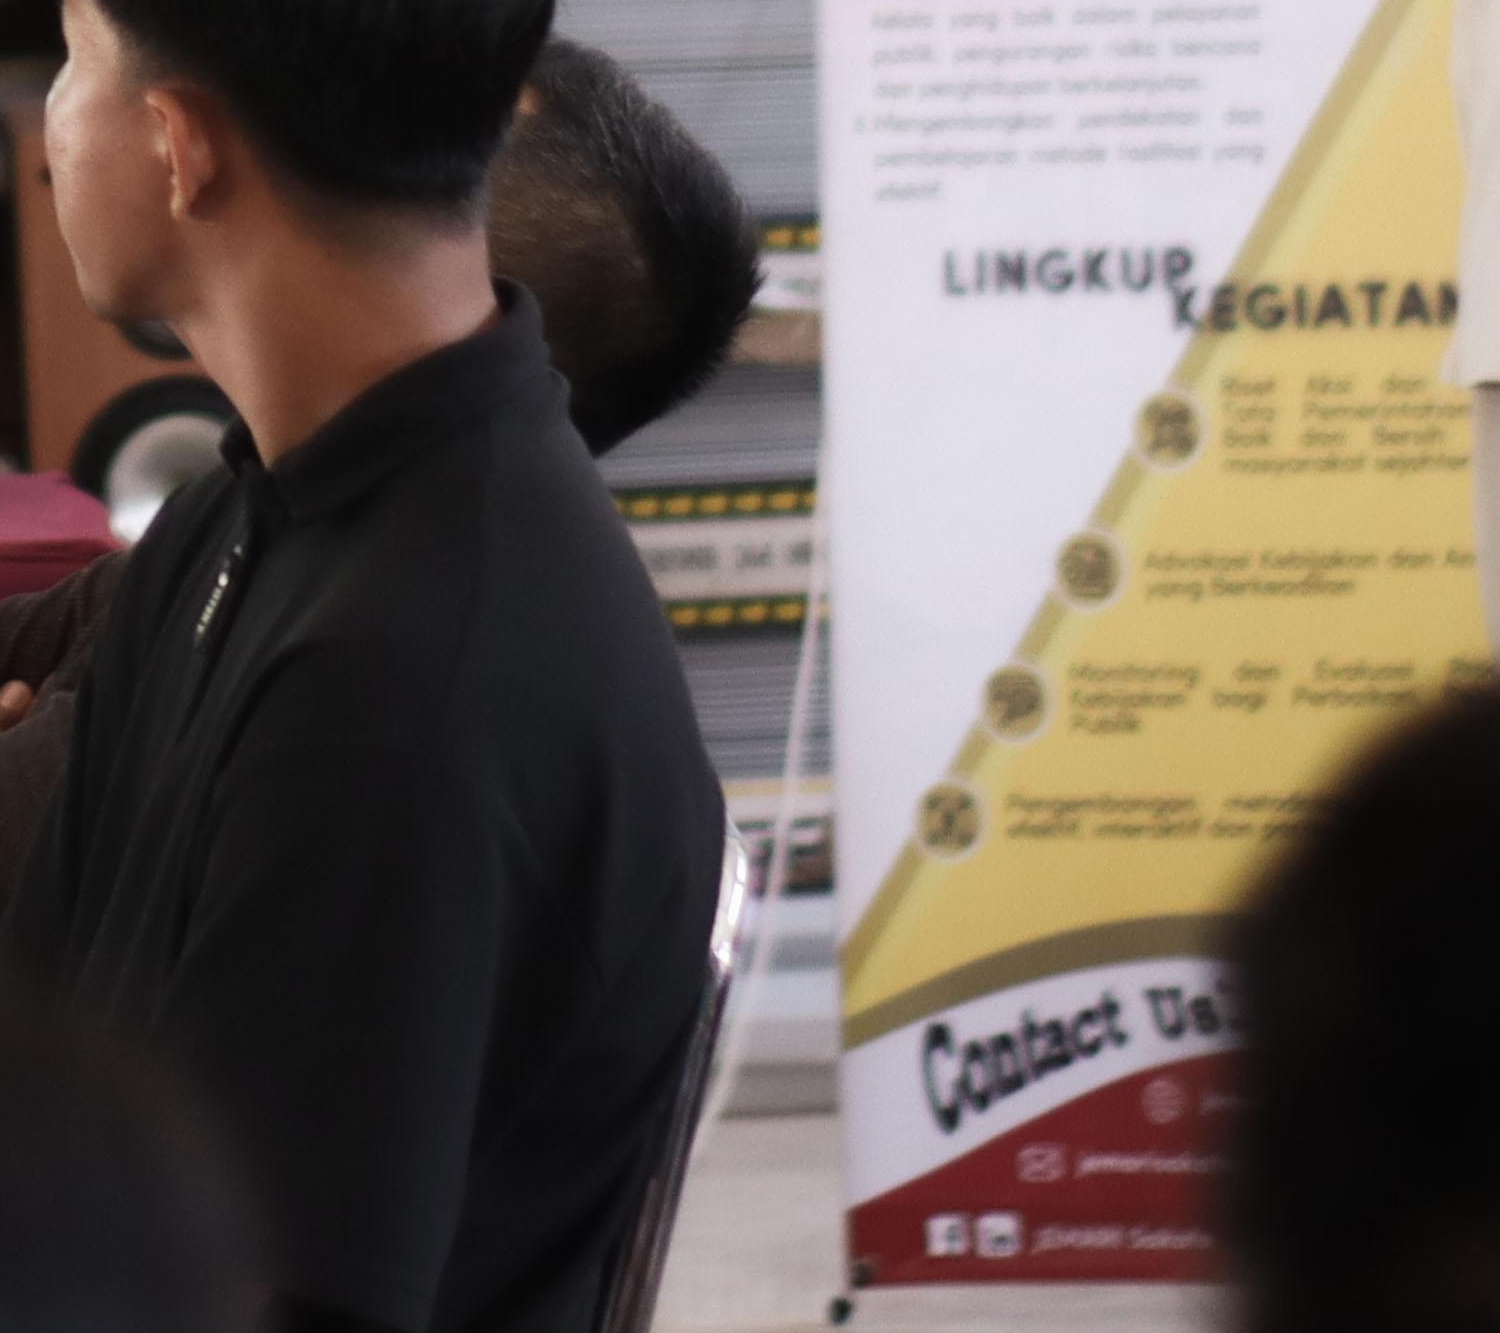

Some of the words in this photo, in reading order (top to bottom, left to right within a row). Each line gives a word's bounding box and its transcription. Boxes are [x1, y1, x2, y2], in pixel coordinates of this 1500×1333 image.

[950, 12, 1000, 33] yang
[943, 247, 1195, 299] LINGKUP
[921, 993, 1129, 1134] Contact
